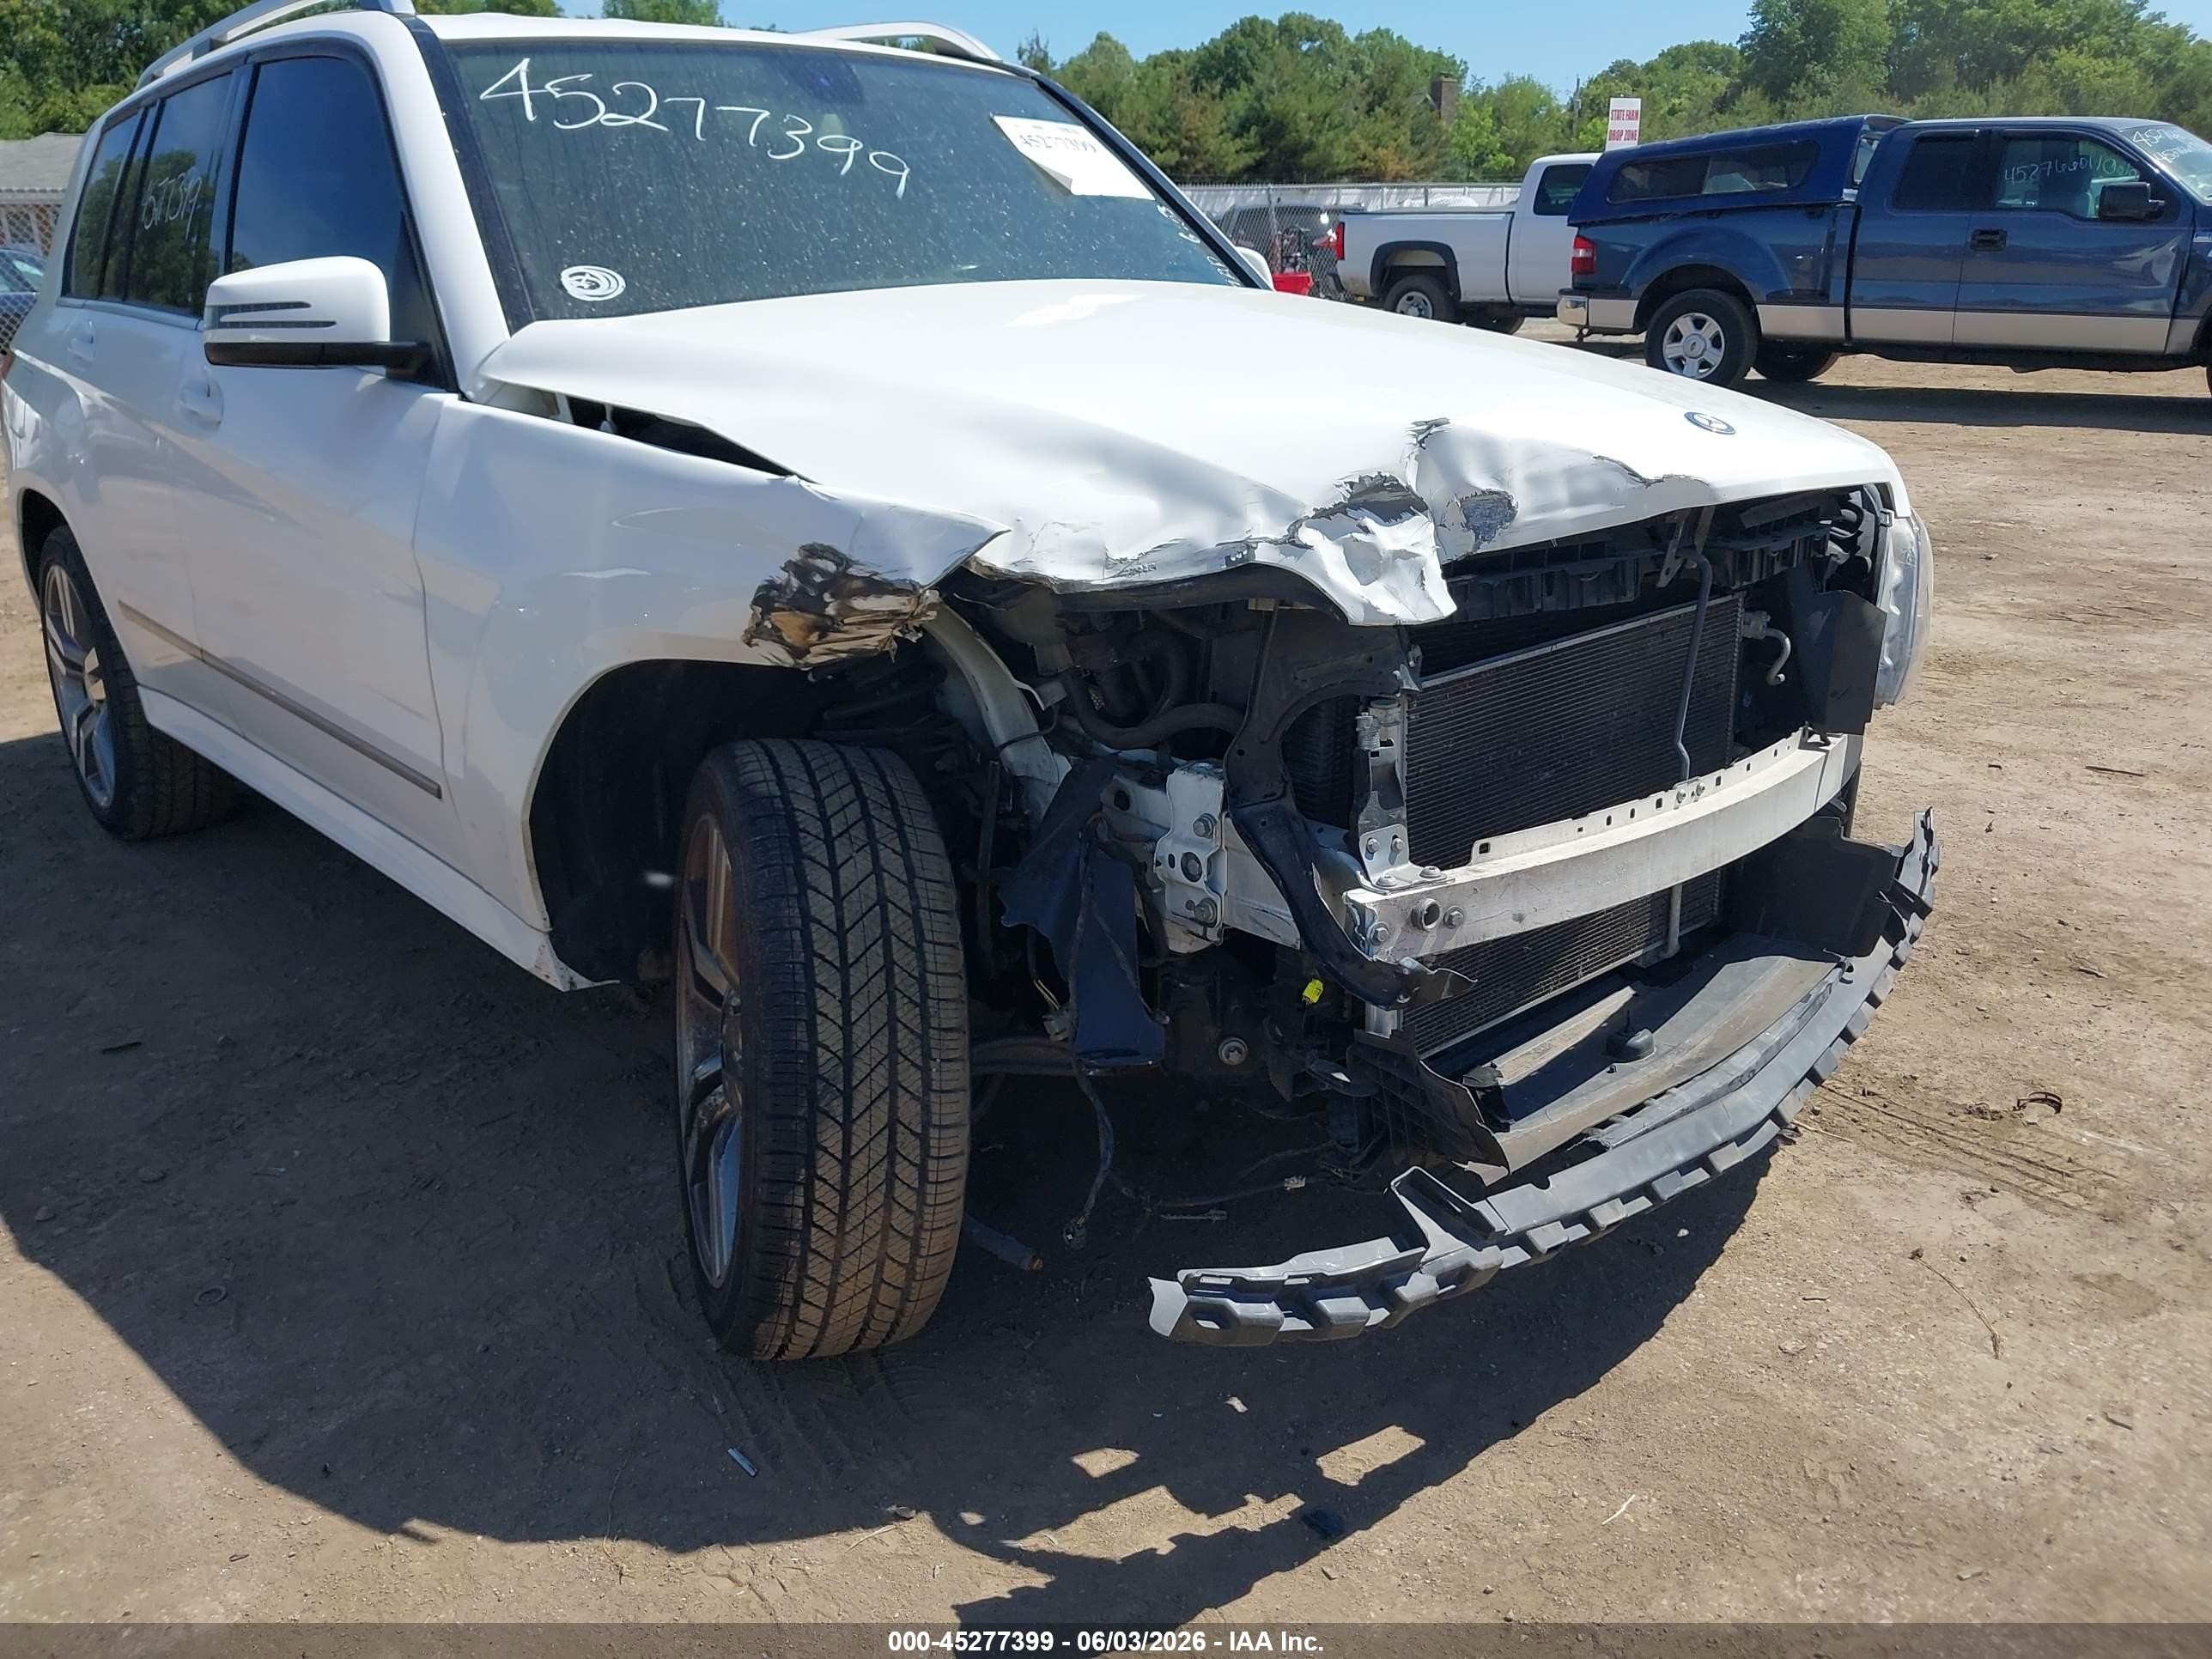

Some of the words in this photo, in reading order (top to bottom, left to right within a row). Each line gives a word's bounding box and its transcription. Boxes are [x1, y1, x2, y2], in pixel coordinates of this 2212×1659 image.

[1611, 109, 1625, 121] STATE
[1626, 109, 1639, 121] FARM
[479, 58, 911, 199] 45277399
[1608, 129, 1623, 141] DROP
[1624, 129, 1637, 141] ZONE
